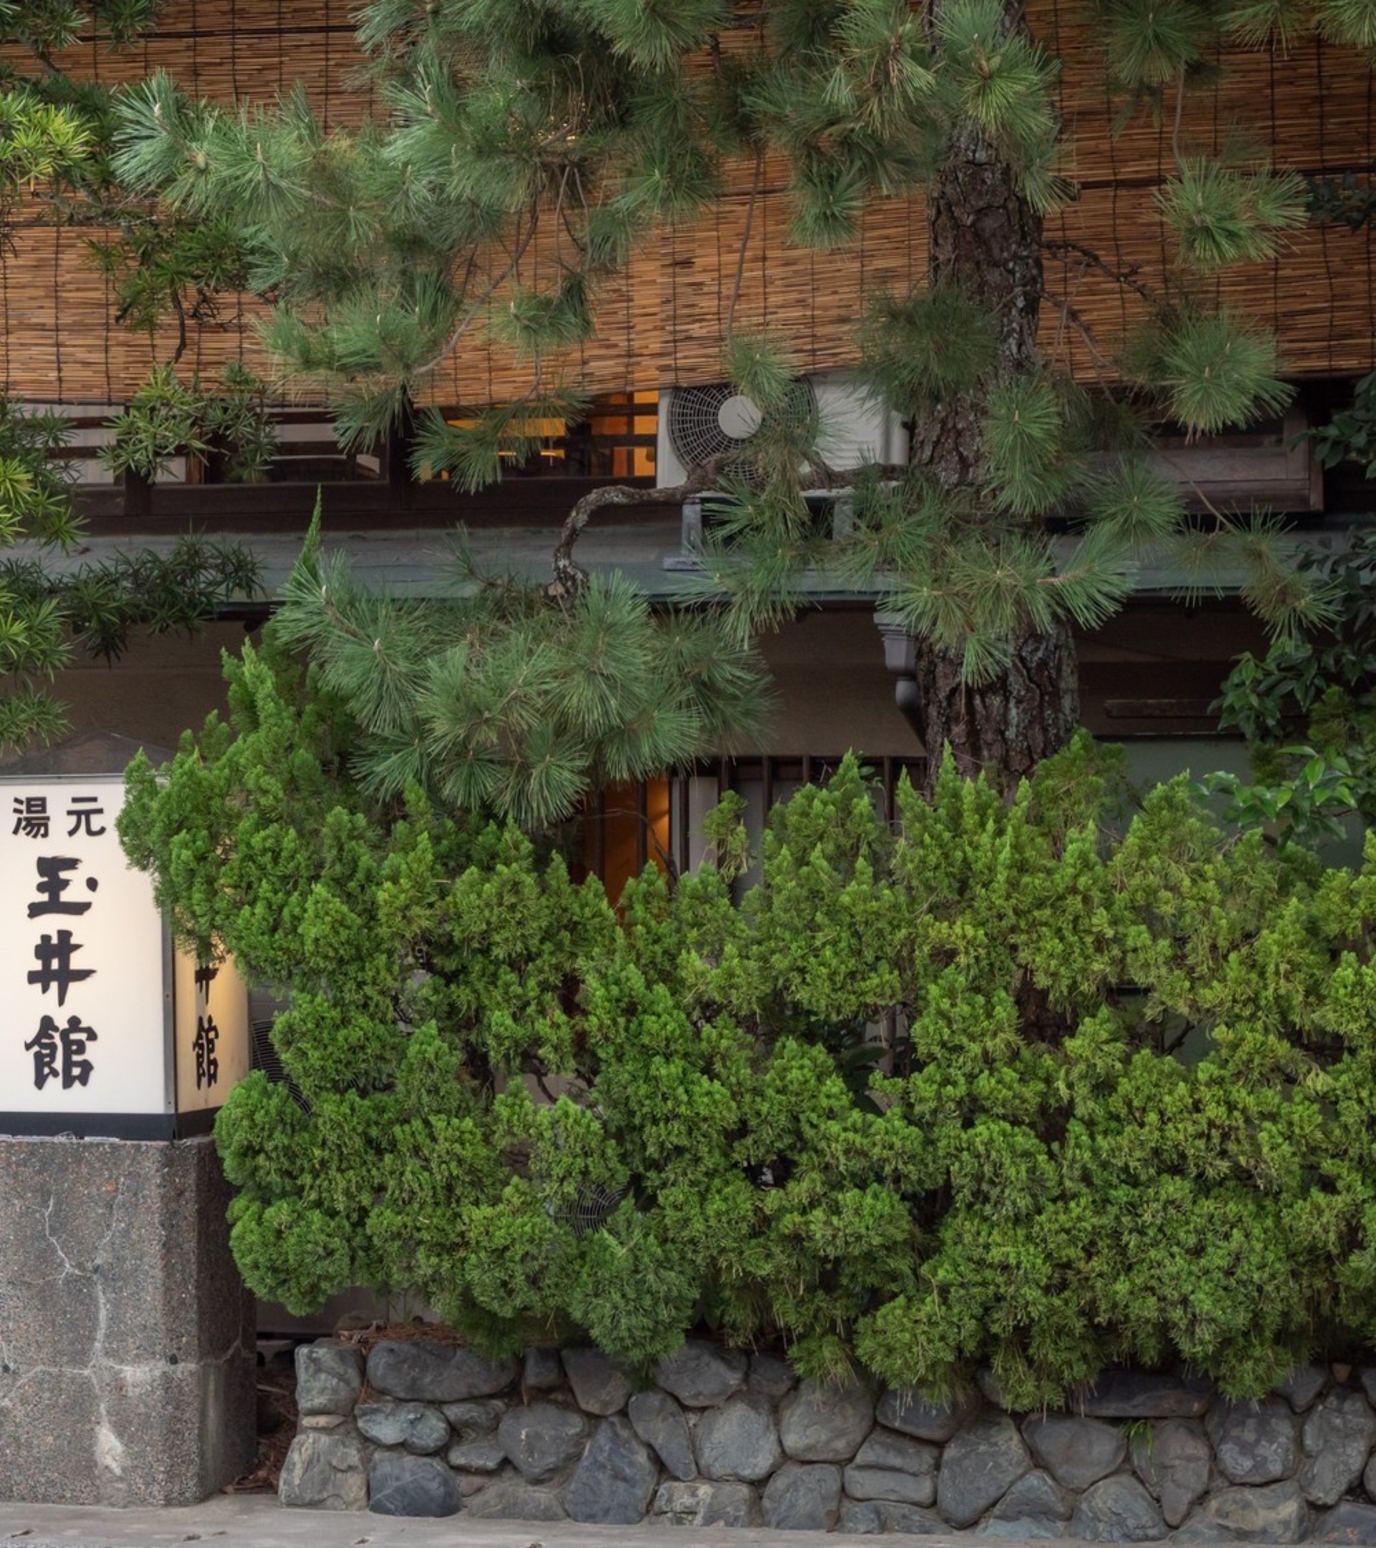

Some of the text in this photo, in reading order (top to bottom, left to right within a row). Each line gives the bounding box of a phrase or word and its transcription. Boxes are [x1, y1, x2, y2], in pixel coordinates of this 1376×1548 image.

[12, 796, 106, 838] 湯元
[25, 855, 99, 1091] 玉井館
